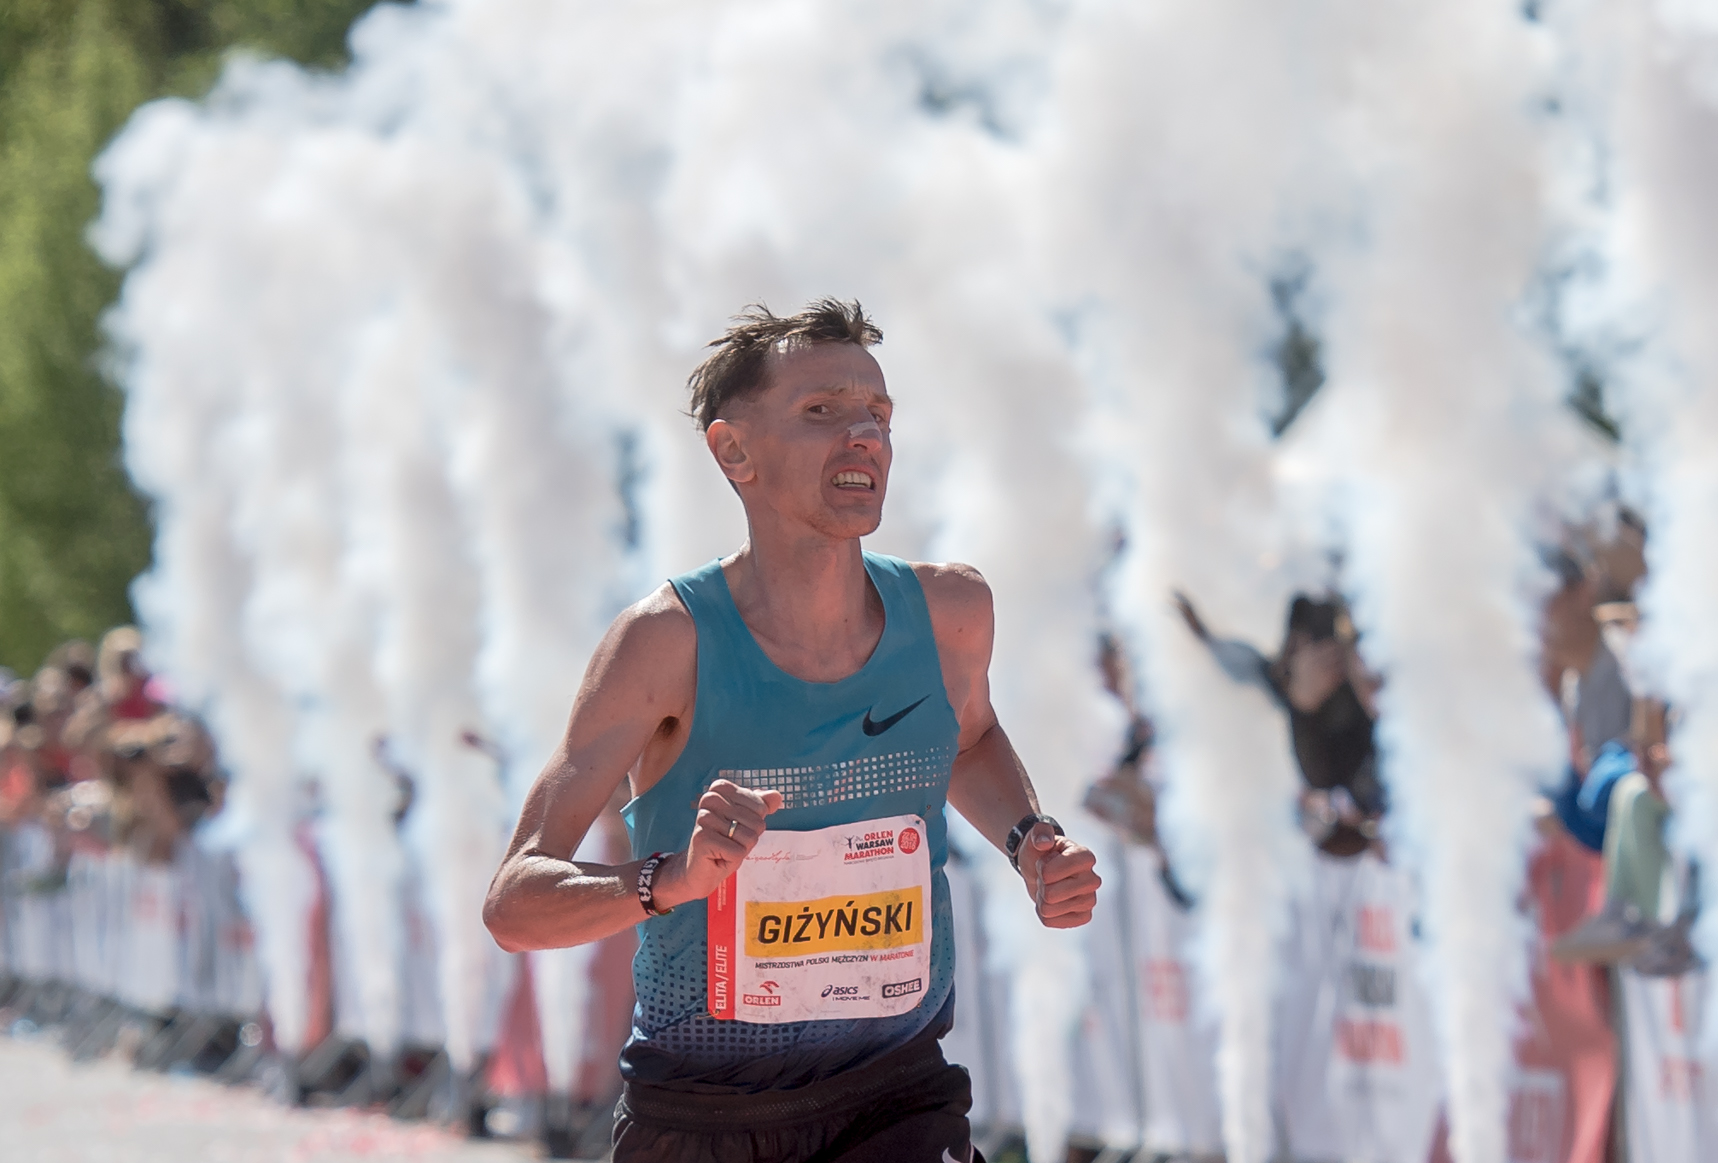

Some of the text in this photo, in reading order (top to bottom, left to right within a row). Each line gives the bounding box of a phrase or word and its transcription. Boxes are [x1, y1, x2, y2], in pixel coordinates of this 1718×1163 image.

[864, 830, 894, 841] ORLEN
[856, 838, 894, 851] WARSAW
[844, 847, 894, 860] MARATHON
[757, 900, 913, 944] GIŻYŃSKI
[755, 950, 915, 970] MISTRZOSTWA POLSKI MĘŻCZYZN W MARATONIE
[833, 986, 859, 995] asics
[884, 980, 920, 996] OSHEE
[744, 996, 780, 1006] ORLEN
